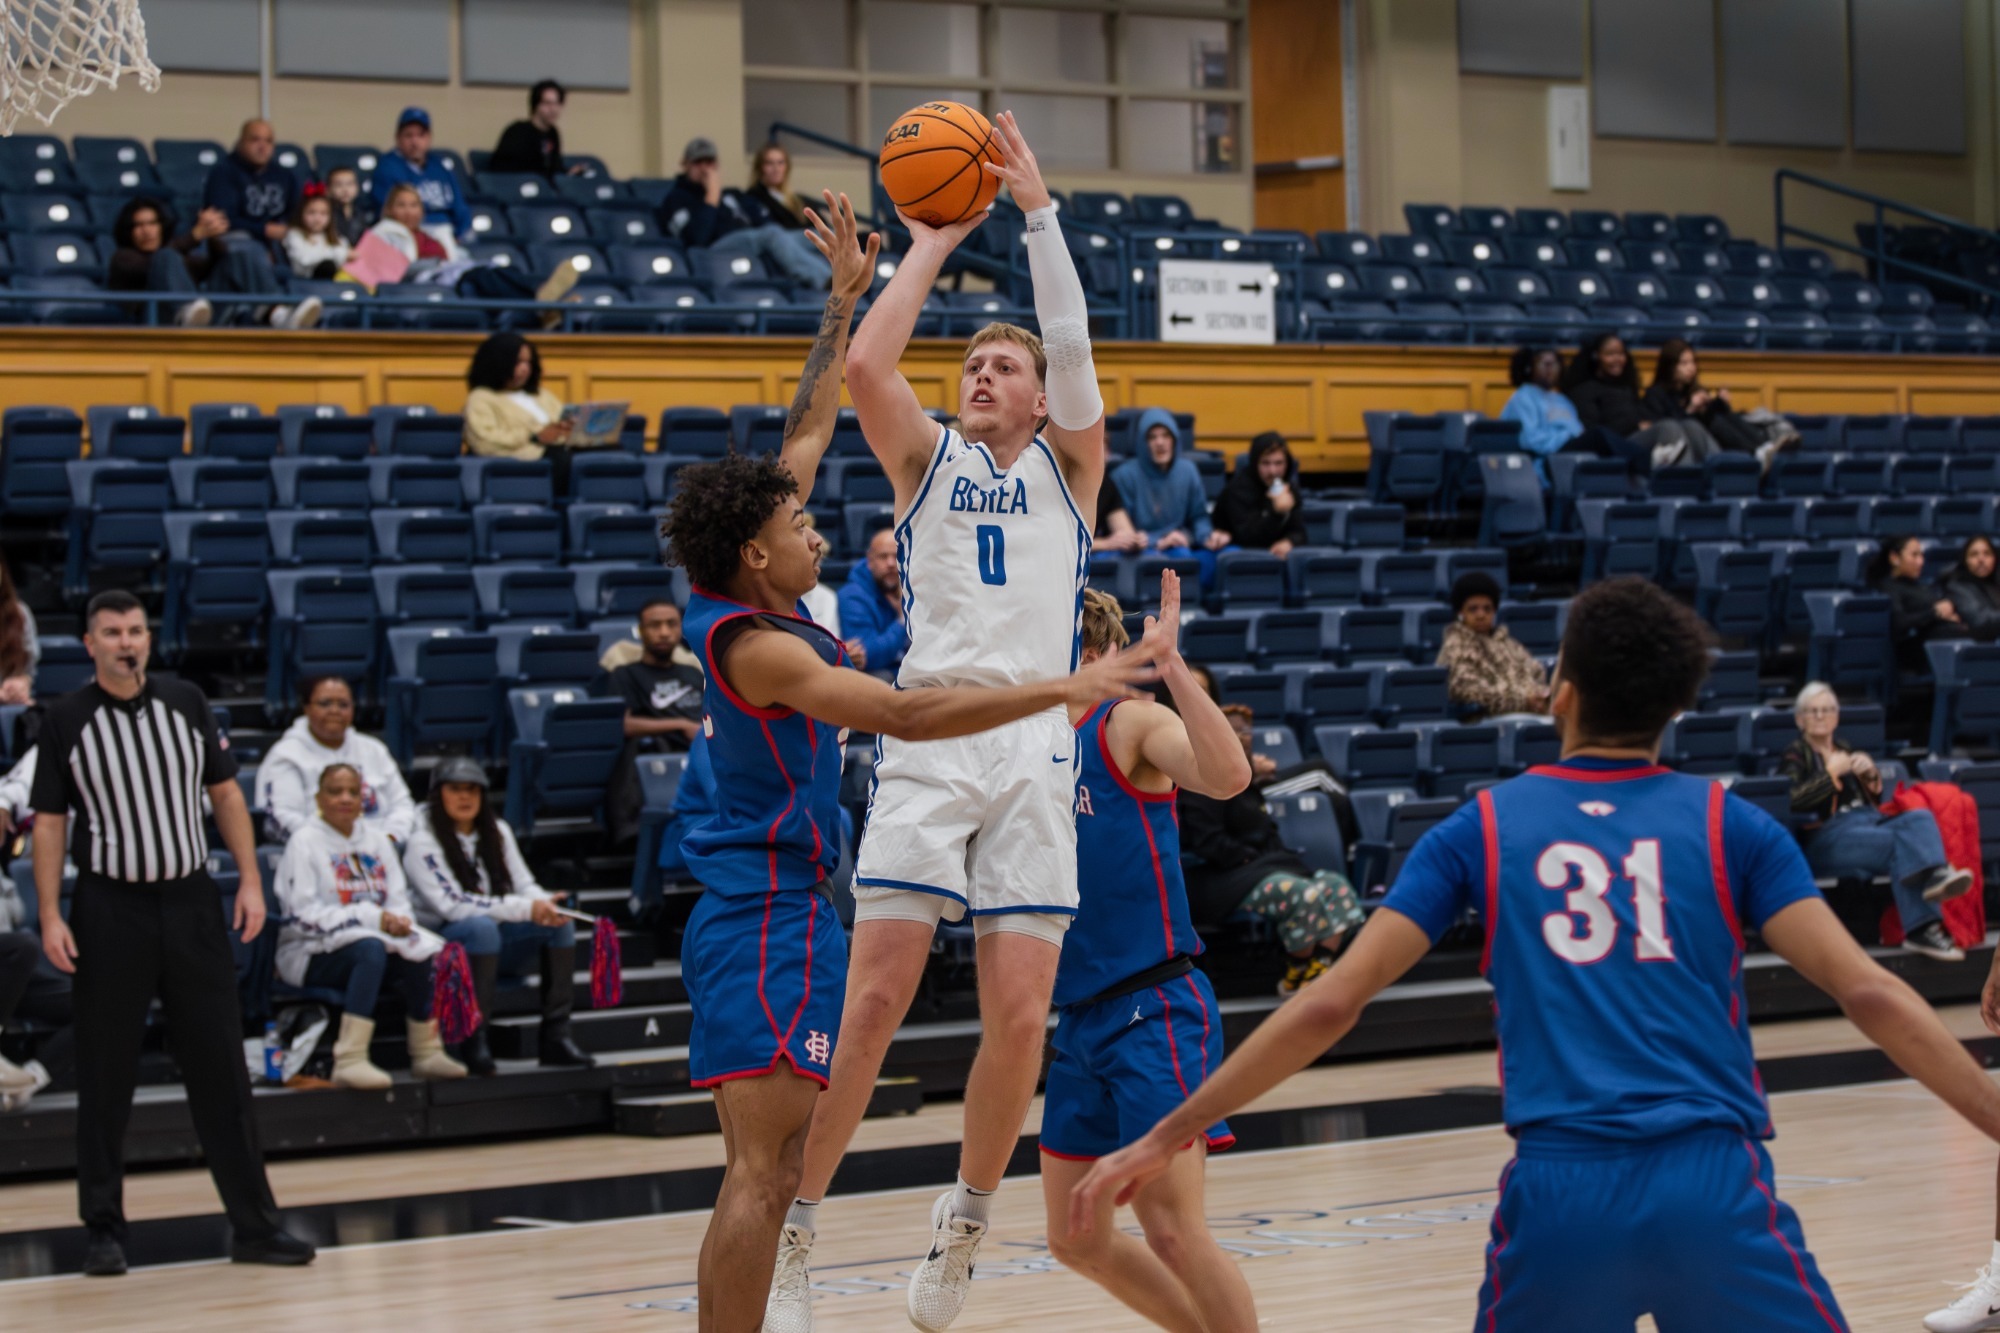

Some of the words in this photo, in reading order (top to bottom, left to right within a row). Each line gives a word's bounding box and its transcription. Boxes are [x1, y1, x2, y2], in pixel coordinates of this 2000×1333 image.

[976, 524, 1007, 587] 0
[1535, 838, 1677, 966] 31
[645, 1018, 660, 1036] A
